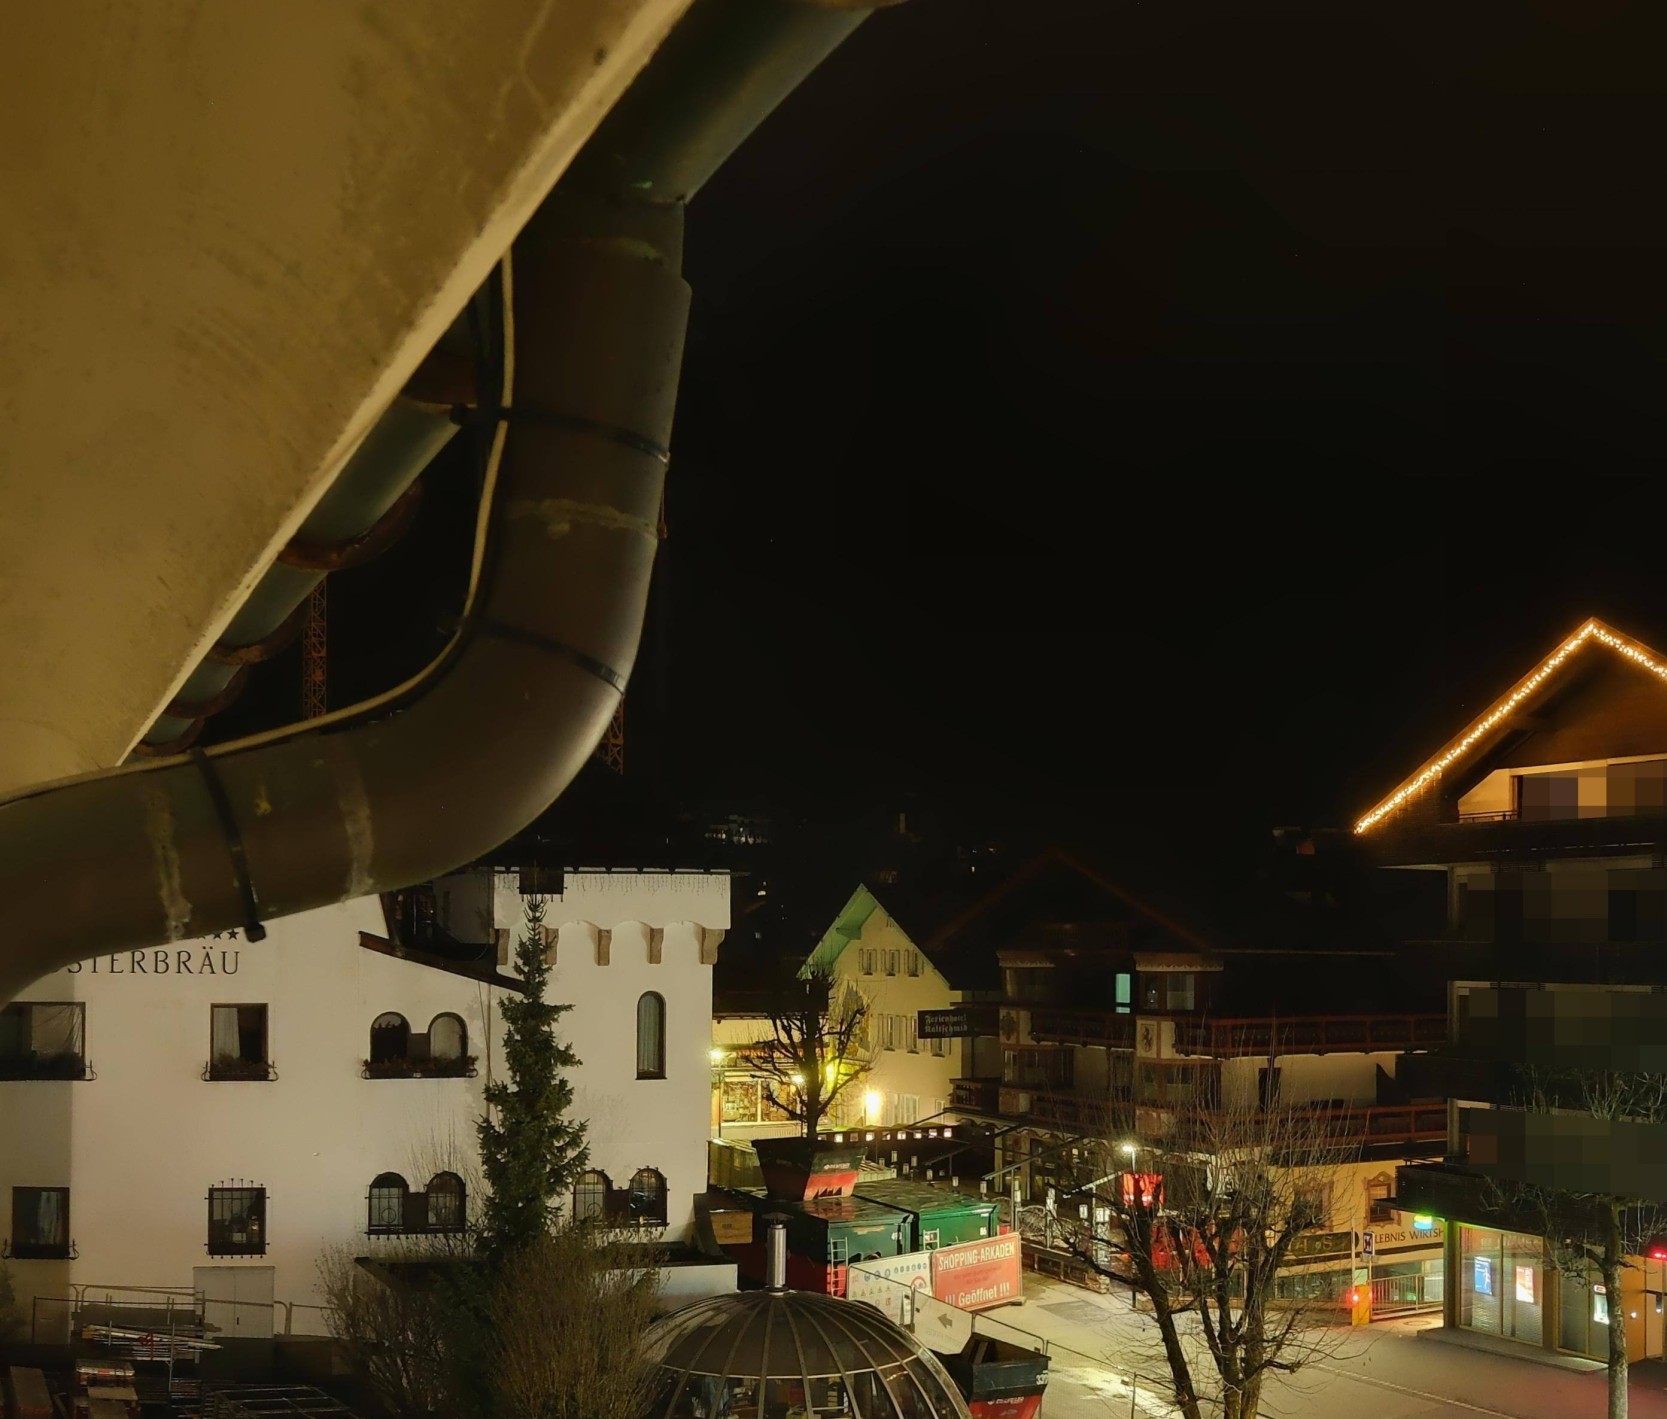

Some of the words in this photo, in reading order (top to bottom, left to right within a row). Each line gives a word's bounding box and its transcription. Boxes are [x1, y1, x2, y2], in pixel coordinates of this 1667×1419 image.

[52, 946, 240, 975] STERBRÄU
[1374, 1232, 1406, 1244] LEBNIS
[938, 1241, 1015, 1271] SHOPPING-ARKADEN
[959, 1285, 998, 1307] Geöffnet
